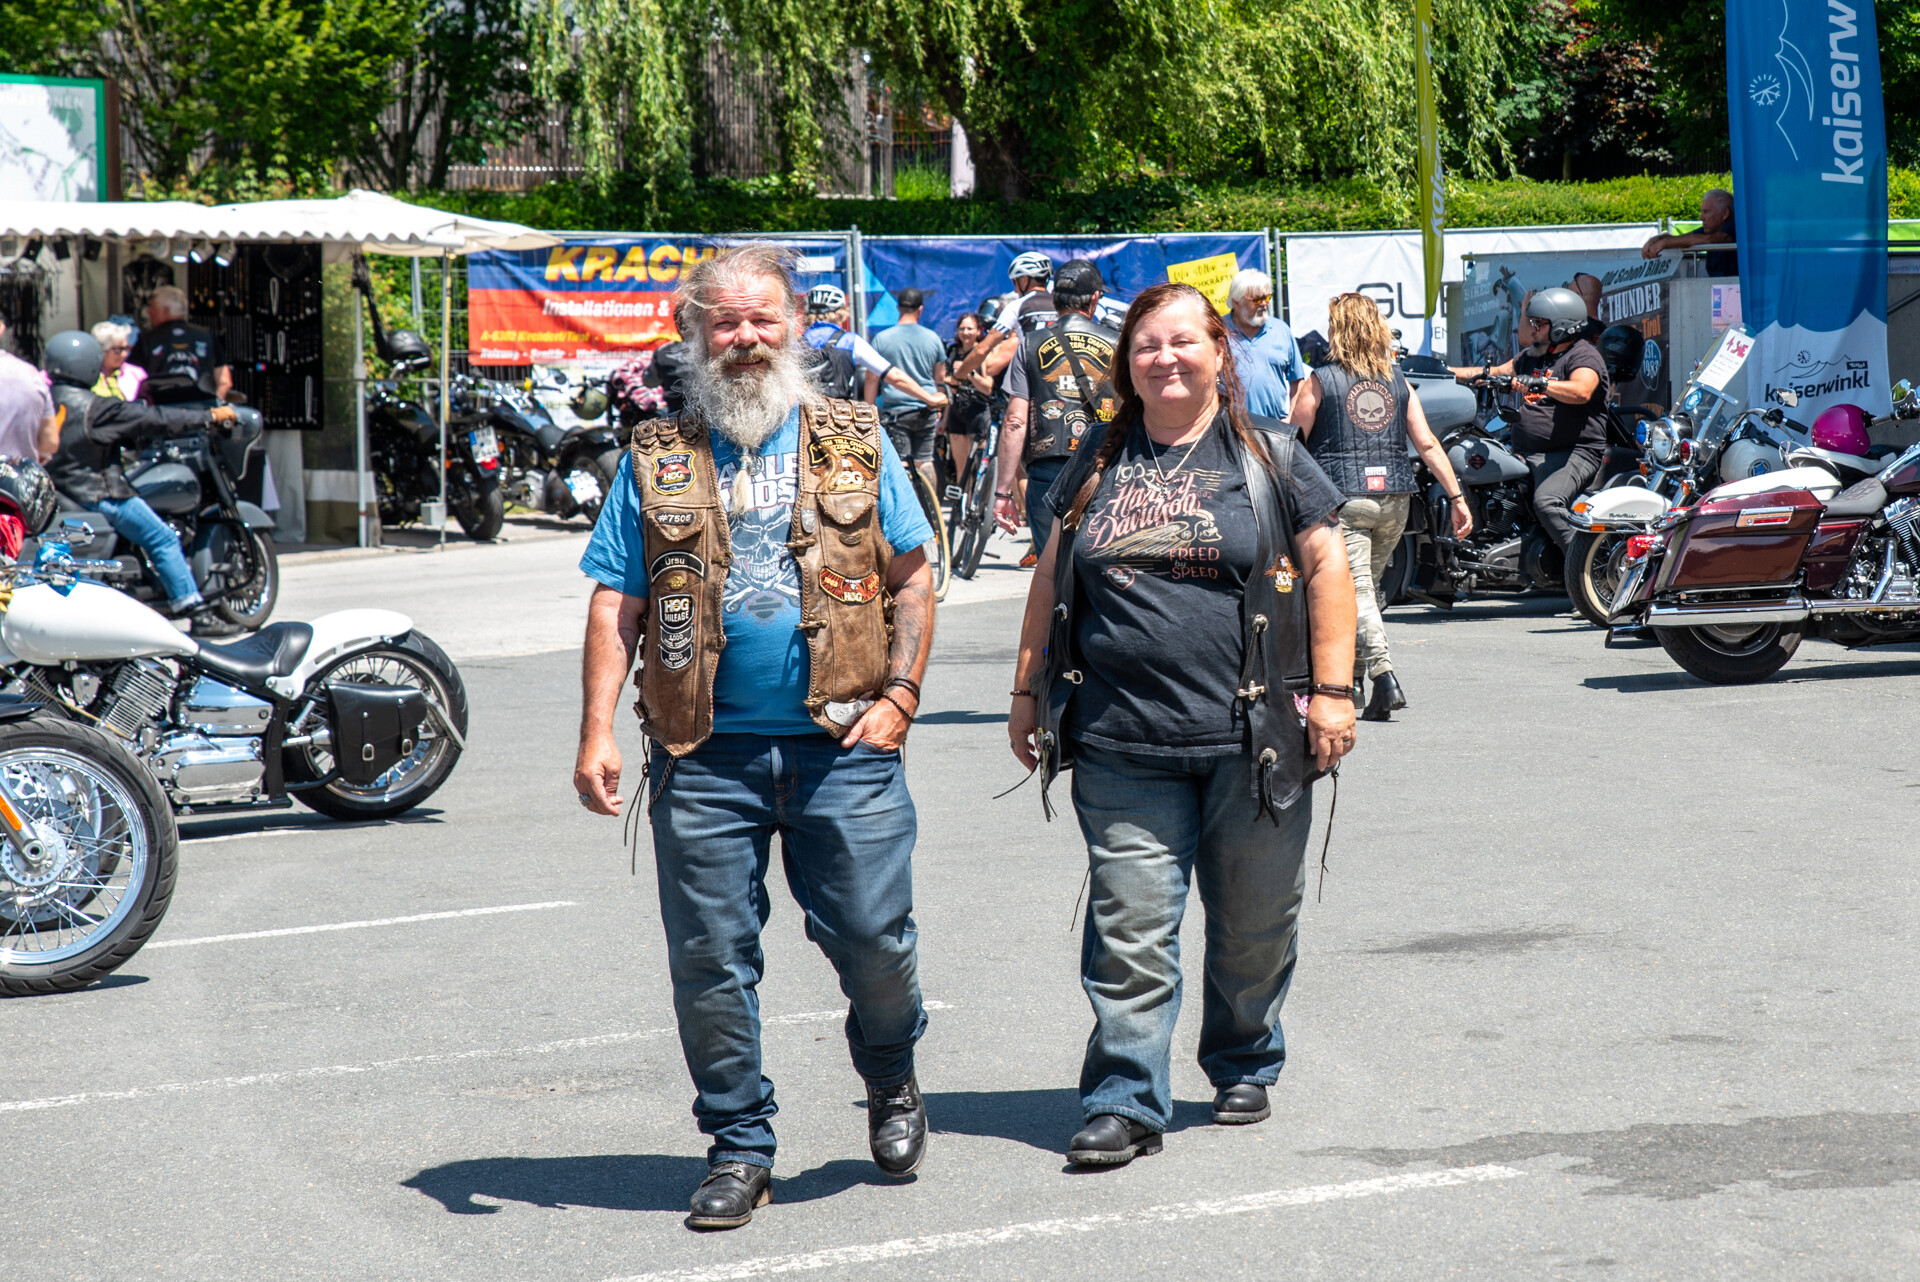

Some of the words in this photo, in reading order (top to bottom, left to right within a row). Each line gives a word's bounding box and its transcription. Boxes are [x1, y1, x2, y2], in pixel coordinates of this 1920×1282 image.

[1612, 262, 1645, 284] School
[1644, 258, 1672, 278] Bikes
[542, 299, 654, 316] Installationen
[1607, 282, 1662, 323] THUNDER
[837, 470, 863, 485] OG
[1115, 463, 1160, 483] 1903
[657, 514, 692, 523] #7505
[1169, 547, 1220, 561] FREED
[1174, 560, 1187, 568] by
[1172, 566, 1219, 580] SPEED
[664, 598, 690, 613] HOG
